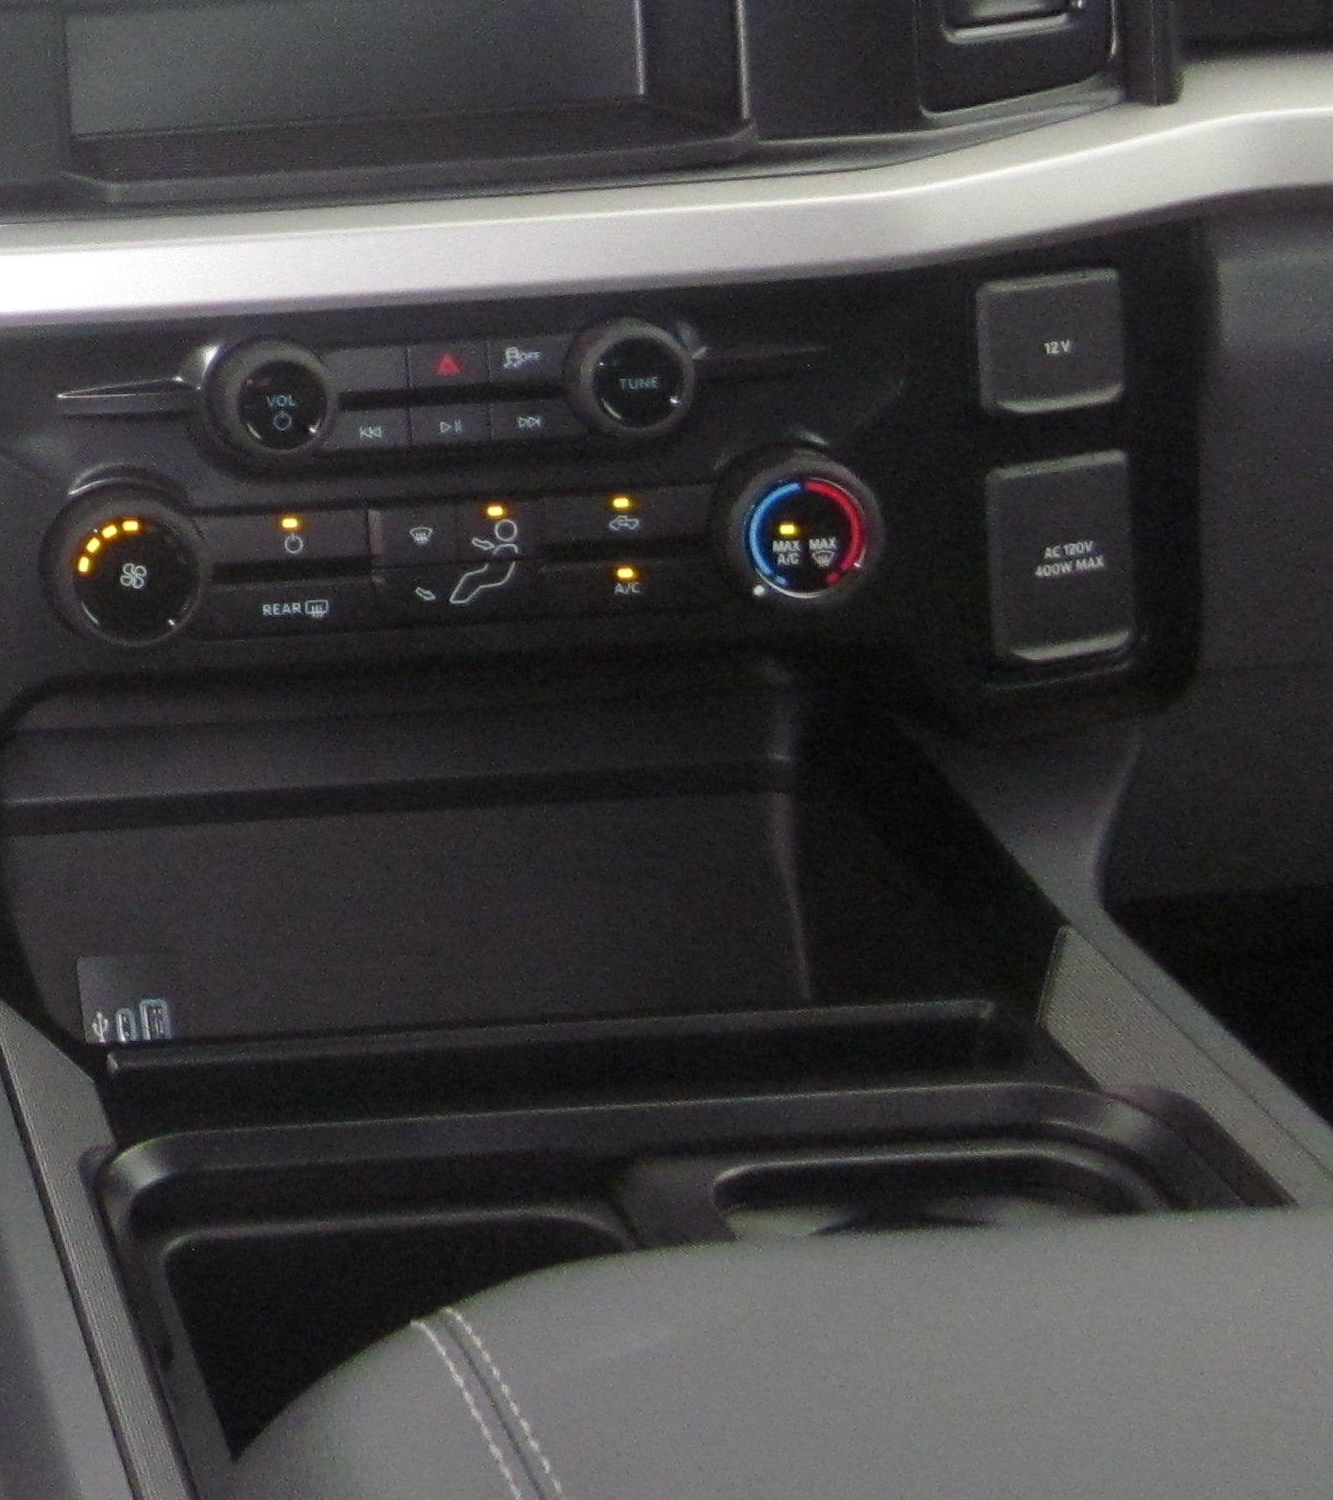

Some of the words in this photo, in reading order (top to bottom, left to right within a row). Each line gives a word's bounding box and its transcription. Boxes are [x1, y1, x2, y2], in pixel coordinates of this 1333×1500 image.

[618, 376, 661, 391] TUNE
[266, 394, 297, 408] VOL
[772, 539, 801, 554] MAX
[808, 536, 837, 552] MAX
[1043, 544, 1061, 559] AC
[1063, 540, 1094, 556] 120V
[777, 552, 800, 566] A/C
[1034, 561, 1073, 578] 400W
[1075, 555, 1104, 572] MAX
[614, 581, 641, 595] A/C
[262, 602, 302, 617] REAR
